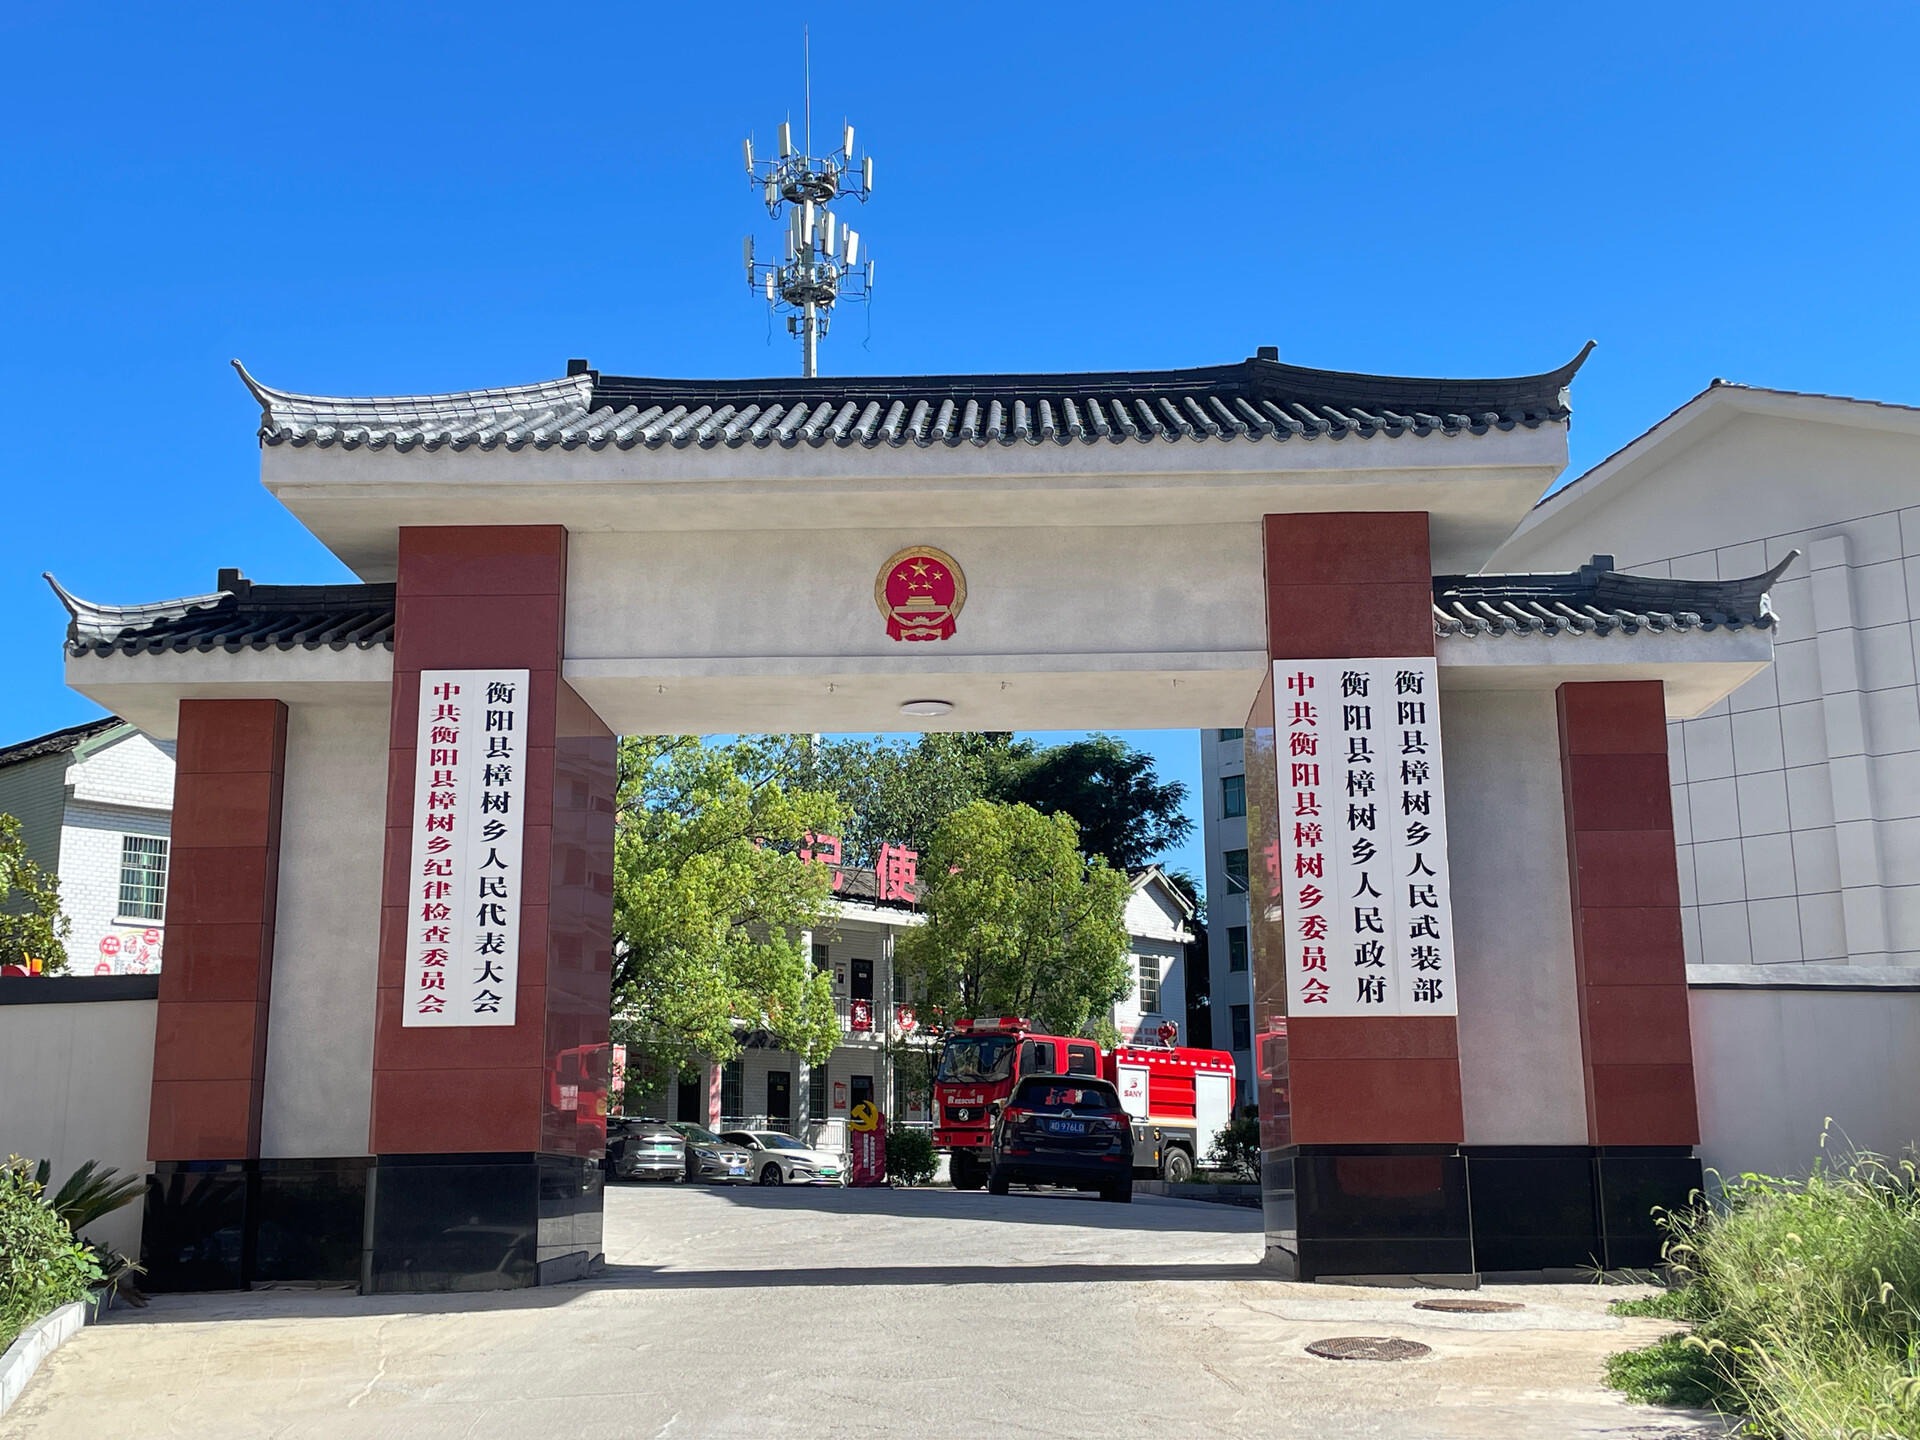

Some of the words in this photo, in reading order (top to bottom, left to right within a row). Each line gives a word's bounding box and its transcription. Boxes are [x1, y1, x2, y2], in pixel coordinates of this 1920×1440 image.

[416, 682, 461, 1014] 中共衡阳县樟树乡纪律检查委员会
[472, 681, 516, 1014] 衡阳县樟树乡人民代表大会
[1287, 671, 1331, 1004] 中共衡阳县樟树乡委员会
[1340, 670, 1387, 1004] 衡阳县樟树乡人民政府
[1394, 670, 1443, 1004] 衡阳县樟树乡人民武装部
[1124, 1090, 1143, 1098] SANY
